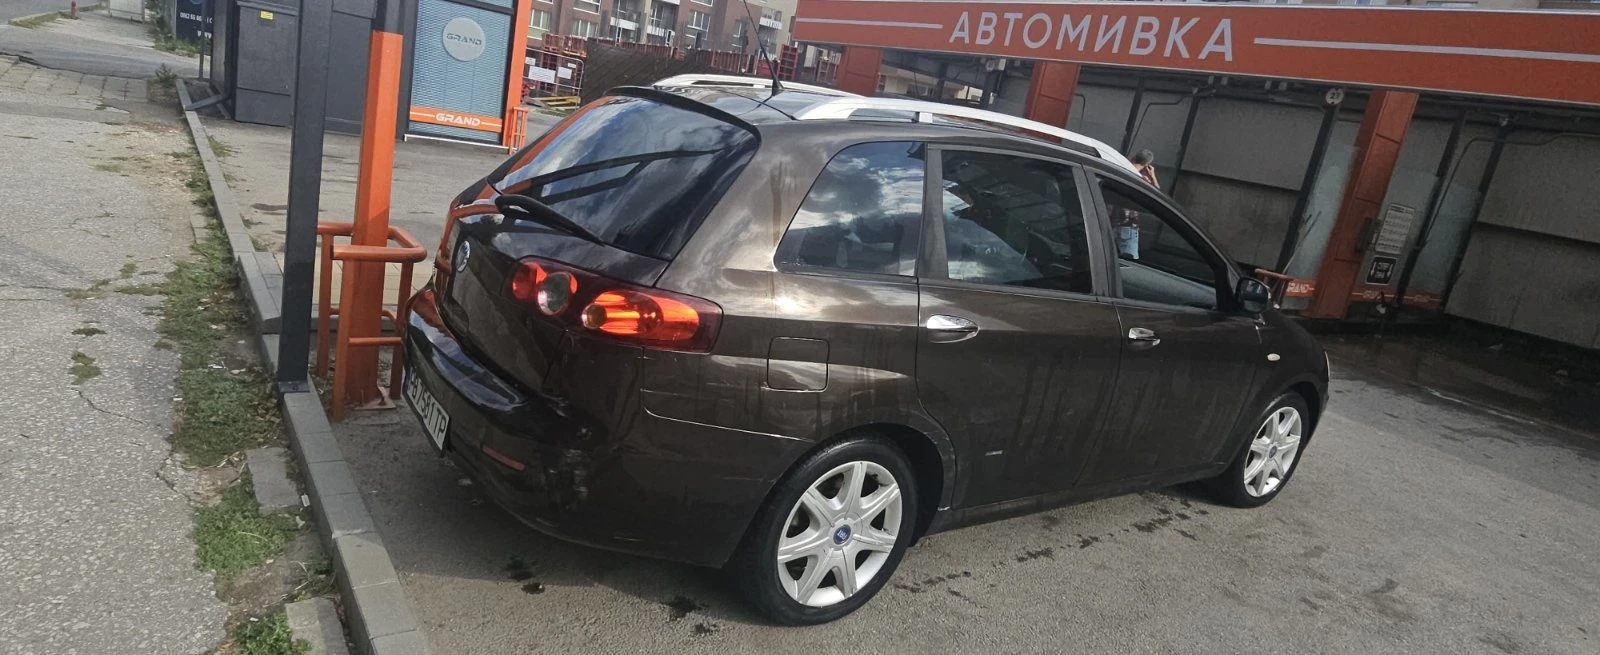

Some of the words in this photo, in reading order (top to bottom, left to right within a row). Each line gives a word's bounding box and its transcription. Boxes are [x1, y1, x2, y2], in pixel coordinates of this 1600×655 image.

[446, 32, 482, 46] GRAND
[949, 11, 1233, 62] АВТОМИВКА
[435, 112, 481, 127] GRAND
[1285, 282, 1310, 293] RAND
